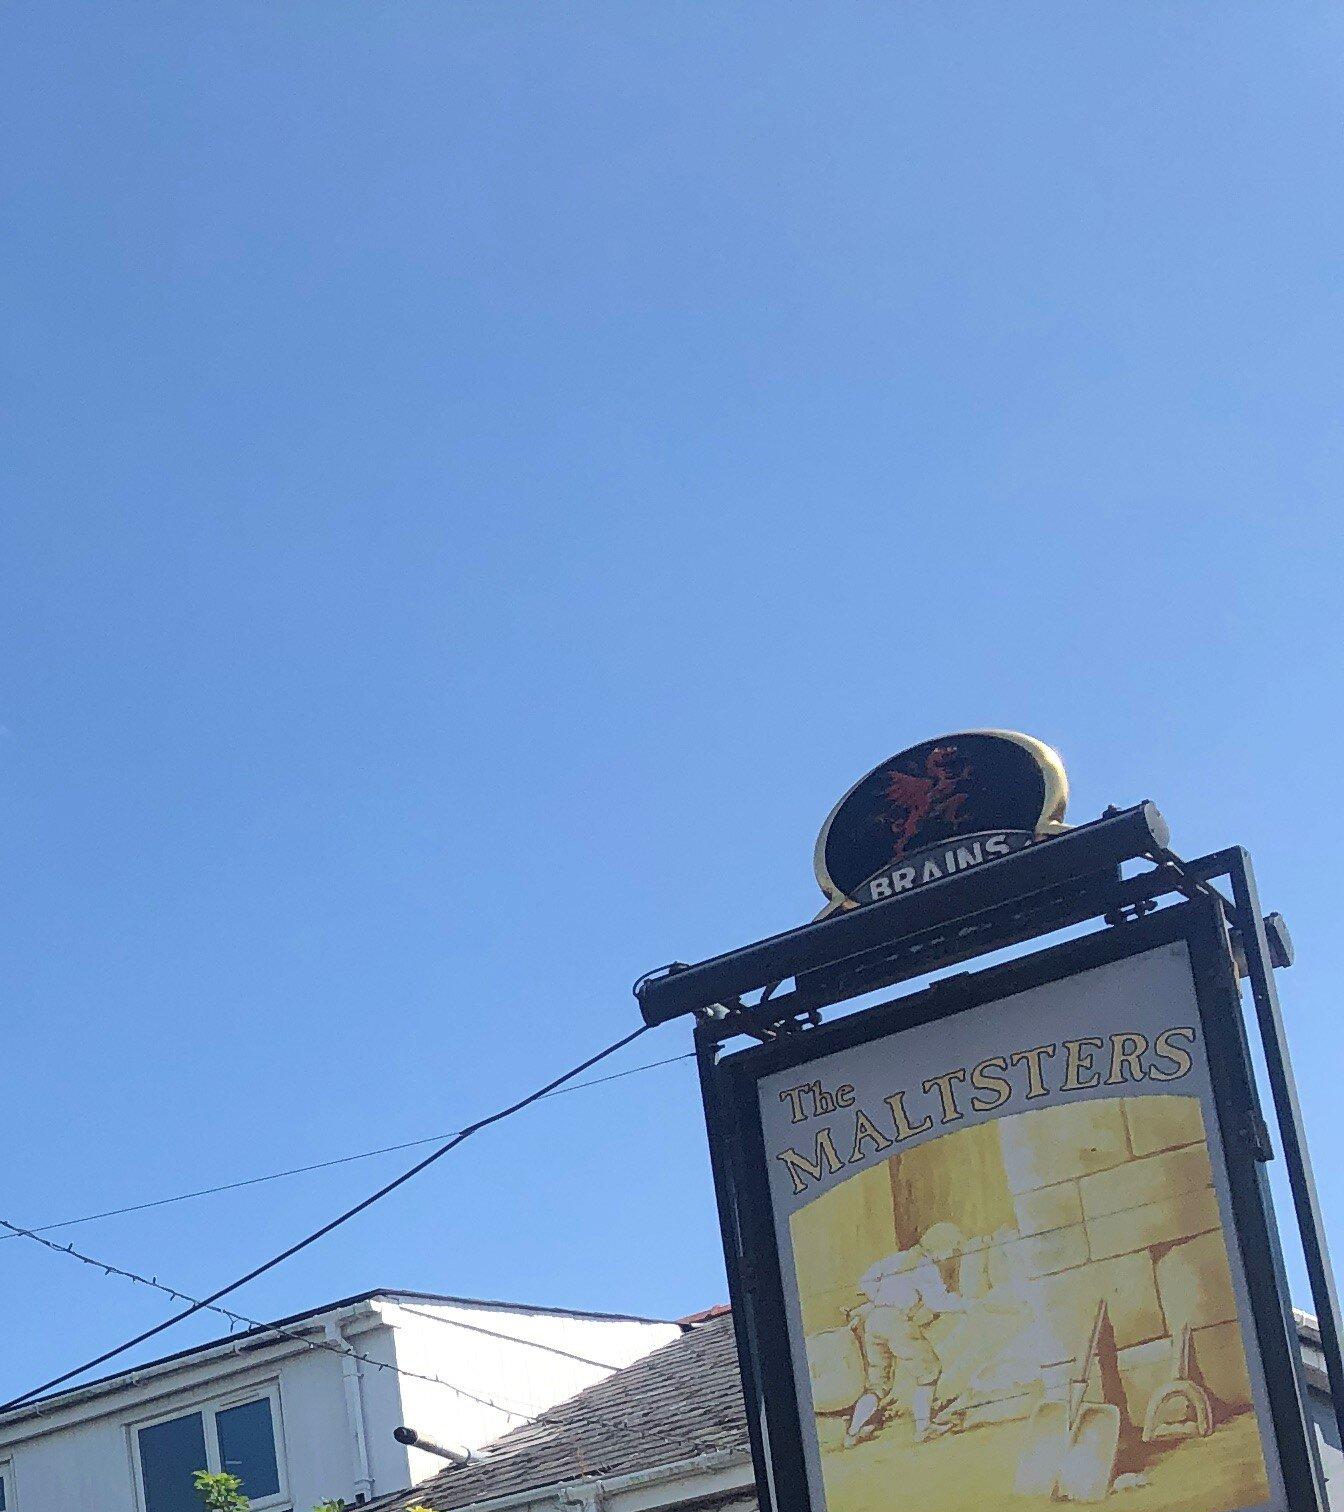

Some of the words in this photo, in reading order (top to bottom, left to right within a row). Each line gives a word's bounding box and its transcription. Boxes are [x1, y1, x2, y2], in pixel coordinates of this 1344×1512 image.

[869, 834, 1011, 901] BRAINS
[776, 1026, 1197, 1195] MALTSTERS
[779, 1080, 856, 1125] The
